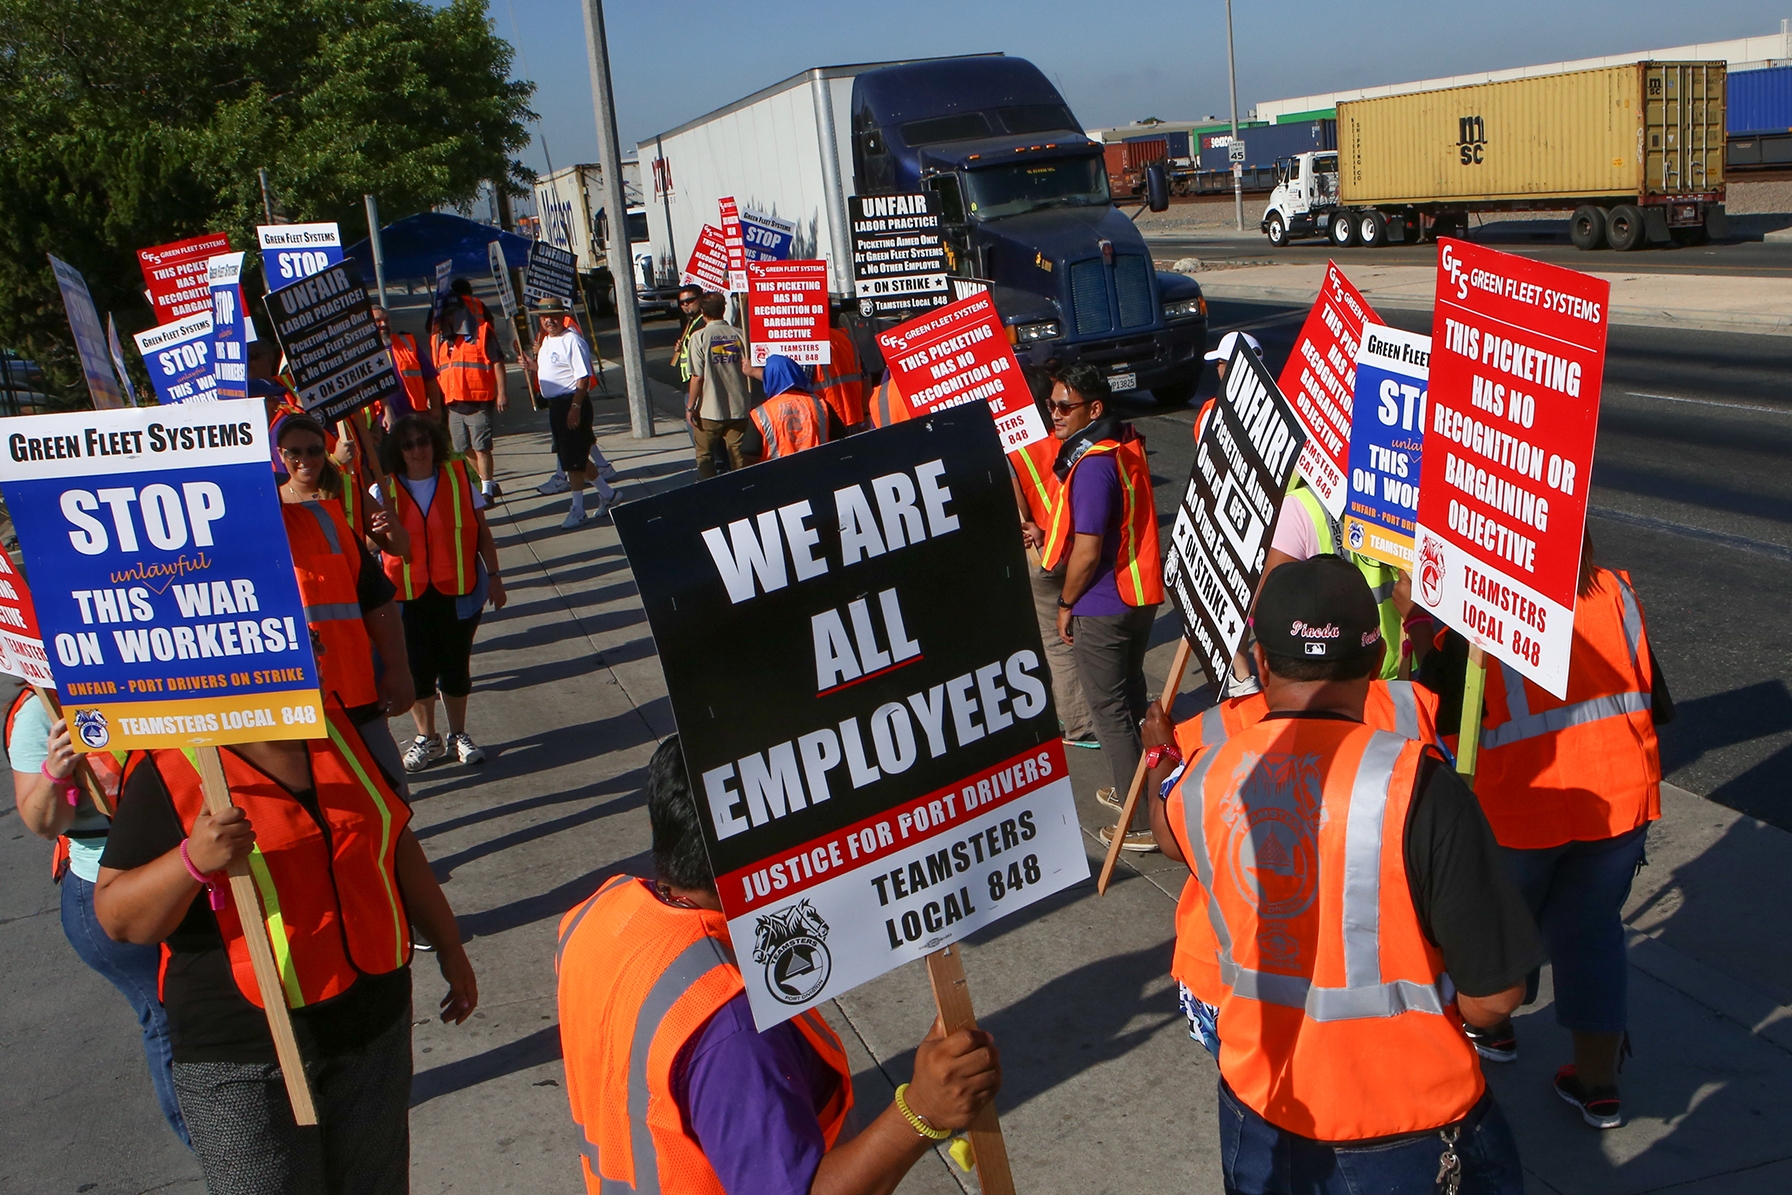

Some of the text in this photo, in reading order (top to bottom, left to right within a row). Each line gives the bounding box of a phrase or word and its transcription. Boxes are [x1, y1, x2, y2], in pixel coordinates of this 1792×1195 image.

[743, 212, 791, 232] GREEN FLEET SYSTEMS
[862, 195, 927, 218] UNFAIR
[265, 232, 336, 244] GREEN FLEET SYSTEMS
[746, 226, 781, 249] STOP
[855, 216, 938, 232] LABOR PRACTICE!
[160, 239, 226, 258] GREEN FLEET SYSTEMS
[539, 245, 571, 265] UNFAIR
[855, 247, 944, 263] AT GREEN FLEET SYSTEMS
[858, 235, 938, 250] PICKETING AIMED ONLY
[153, 268, 176, 280] THIS
[278, 252, 329, 279] STOP
[880, 260, 940, 273] OTHER EMPLOYER
[176, 276, 195, 289] HAS
[280, 268, 350, 315] UNFAIR
[755, 281, 820, 292] THIS PICKETING
[773, 293, 804, 303] HAS NO
[874, 278, 930, 293] ON STRIKE
[1470, 268, 1601, 324] GREEN FLEET SYSTEMS
[280, 288, 365, 336] LABOR PRACTICE!
[754, 305, 823, 315] RECOGNITION OR
[875, 296, 948, 310] TEAMSTERS LOCAL 848
[1344, 292, 1364, 320] GREEN
[142, 337, 163, 348] GREEN
[162, 332, 180, 343] FLEET
[180, 320, 210, 336] SYSTEMS
[344, 322, 377, 344] SYSTEMS
[764, 317, 815, 327] BARGAINING
[768, 329, 812, 339] OBJECTIVE
[905, 300, 989, 340] GREEN FLEET SYSTEMS
[1321, 302, 1343, 338] THIS
[289, 330, 328, 355] PICKETING
[342, 338, 377, 364] EMPLOYER
[780, 344, 819, 352] TEAMSTERS
[898, 324, 993, 373] THIS PICKETING
[1368, 334, 1401, 360] GREEN
[1445, 317, 1582, 398] THIS PICKETING
[159, 341, 208, 376] STOP
[712, 354, 740, 364] SEIU
[930, 351, 976, 380] HAS NO
[1327, 343, 1348, 376] HAS
[167, 382, 193, 400] THIS
[319, 361, 374, 398] ON STRIKE
[910, 364, 992, 408] RECOGNITION
[990, 356, 1011, 374] OR
[326, 375, 396, 418] TEAMSTERS 848
[1471, 374, 1535, 429] HAS NO
[1226, 350, 1297, 488] UNFAIR!
[1296, 391, 1344, 458] OBJECTIVE
[9, 422, 254, 463] GREEN FLEET SYSTEMS
[1008, 429, 1029, 445] 848
[1433, 402, 1576, 496] RECOGNITION OR
[1211, 406, 1274, 527] PICKETING AIMED
[1369, 444, 1408, 478] THIS
[1197, 441, 1247, 531] ONLY GFS
[1315, 476, 1332, 500] 848
[1353, 468, 1376, 497] ON
[1444, 452, 1549, 533] BARGAINING
[60, 481, 226, 555] STOP
[1351, 501, 1376, 518] UNFAIR
[1382, 512, 1400, 526] PORT
[701, 458, 961, 605] WE ARE
[1447, 499, 1536, 573] OBJECTIVE
[110, 552, 212, 584] unlawful
[1194, 497, 1251, 612] OTHER EMPLOYER
[1184, 533, 1229, 625] ON STRIKE
[72, 586, 154, 625] THIS
[172, 578, 260, 619] WAR
[1464, 565, 1547, 633] TEAMSTERS
[810, 587, 922, 692] ALL
[1175, 570, 1226, 682] TEAMSTERS LOCAL 848
[1290, 621, 1340, 638] Pineda
[1462, 600, 1541, 667] LOCAL 848
[54, 616, 300, 668] ON WORKERS!
[67, 668, 305, 697] UNFAIR PORT DRIVERS ON STRIKE
[118, 705, 317, 736] TEAMSTERS LOCAL 848
[701, 649, 1048, 842] EMPLOYEES
[742, 751, 1053, 902] JUSTICE FOR PORT DRIVERS
[871, 809, 1038, 907] TEAMSTERS
[885, 853, 1043, 951] LOCAL 848
[770, 938, 818, 964] TEAMSTERS
